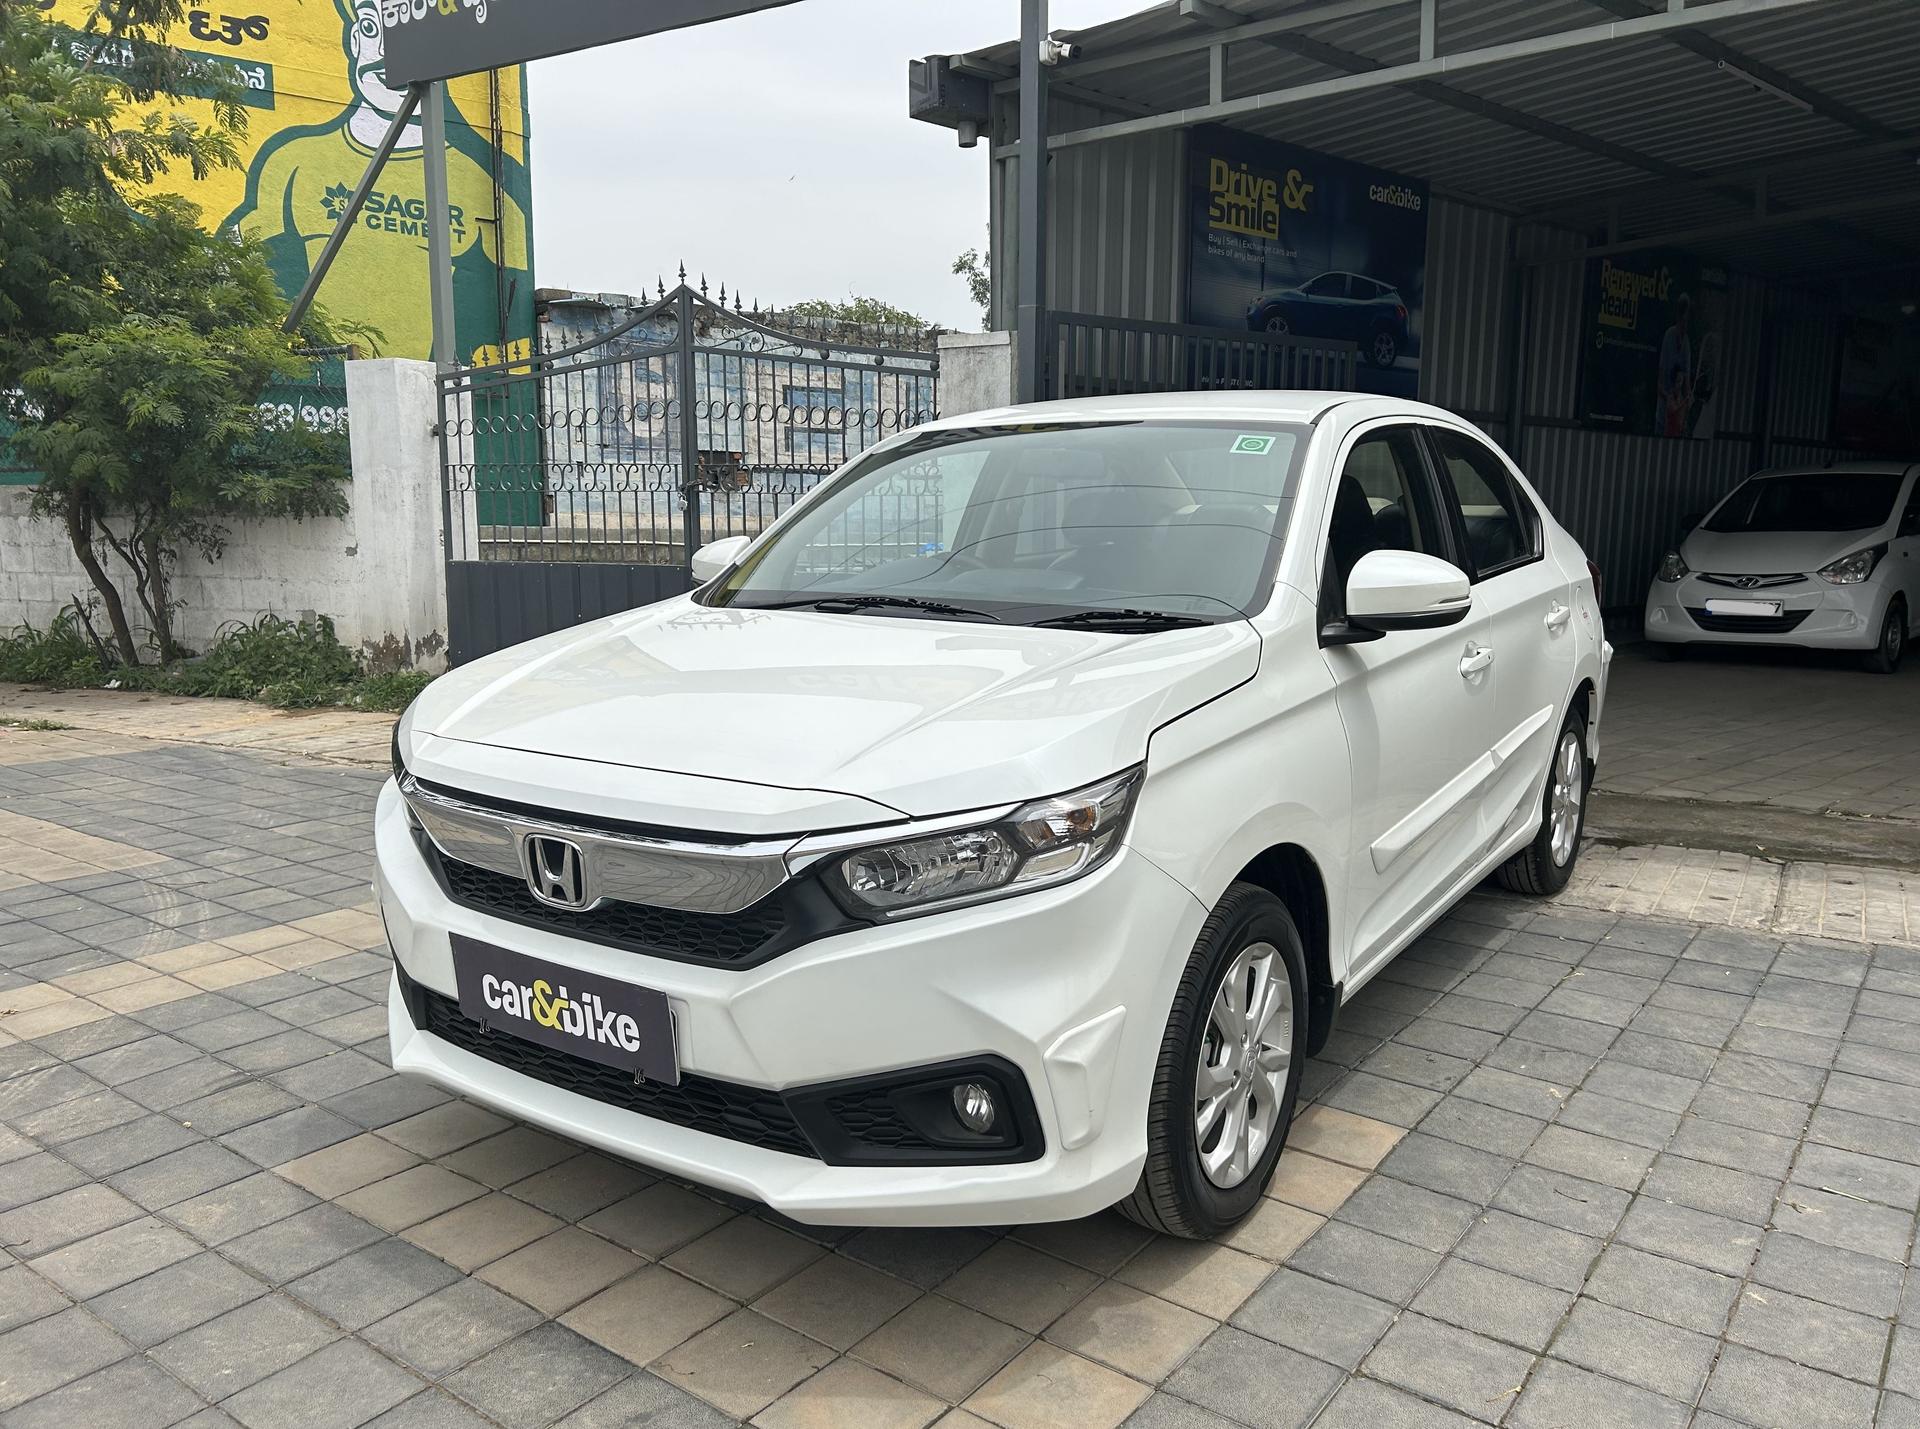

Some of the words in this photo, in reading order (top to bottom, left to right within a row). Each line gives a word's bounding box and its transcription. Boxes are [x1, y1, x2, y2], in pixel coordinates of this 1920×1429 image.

[1209, 158, 1277, 201] Drive
[1283, 168, 1314, 213] &
[1369, 184, 1422, 212] car&bike
[364, 191, 464, 227] SAGR
[1209, 192, 1278, 235] Smile
[1207, 244, 1225, 256] bikes
[1225, 248, 1233, 257] of
[1246, 254, 1265, 264] brand
[1208, 233, 1222, 245] Buy
[1600, 257, 1657, 299] Renewed
[1657, 265, 1673, 302] &
[1600, 291, 1636, 327] Ready
[482, 973, 641, 1053] car&bike
